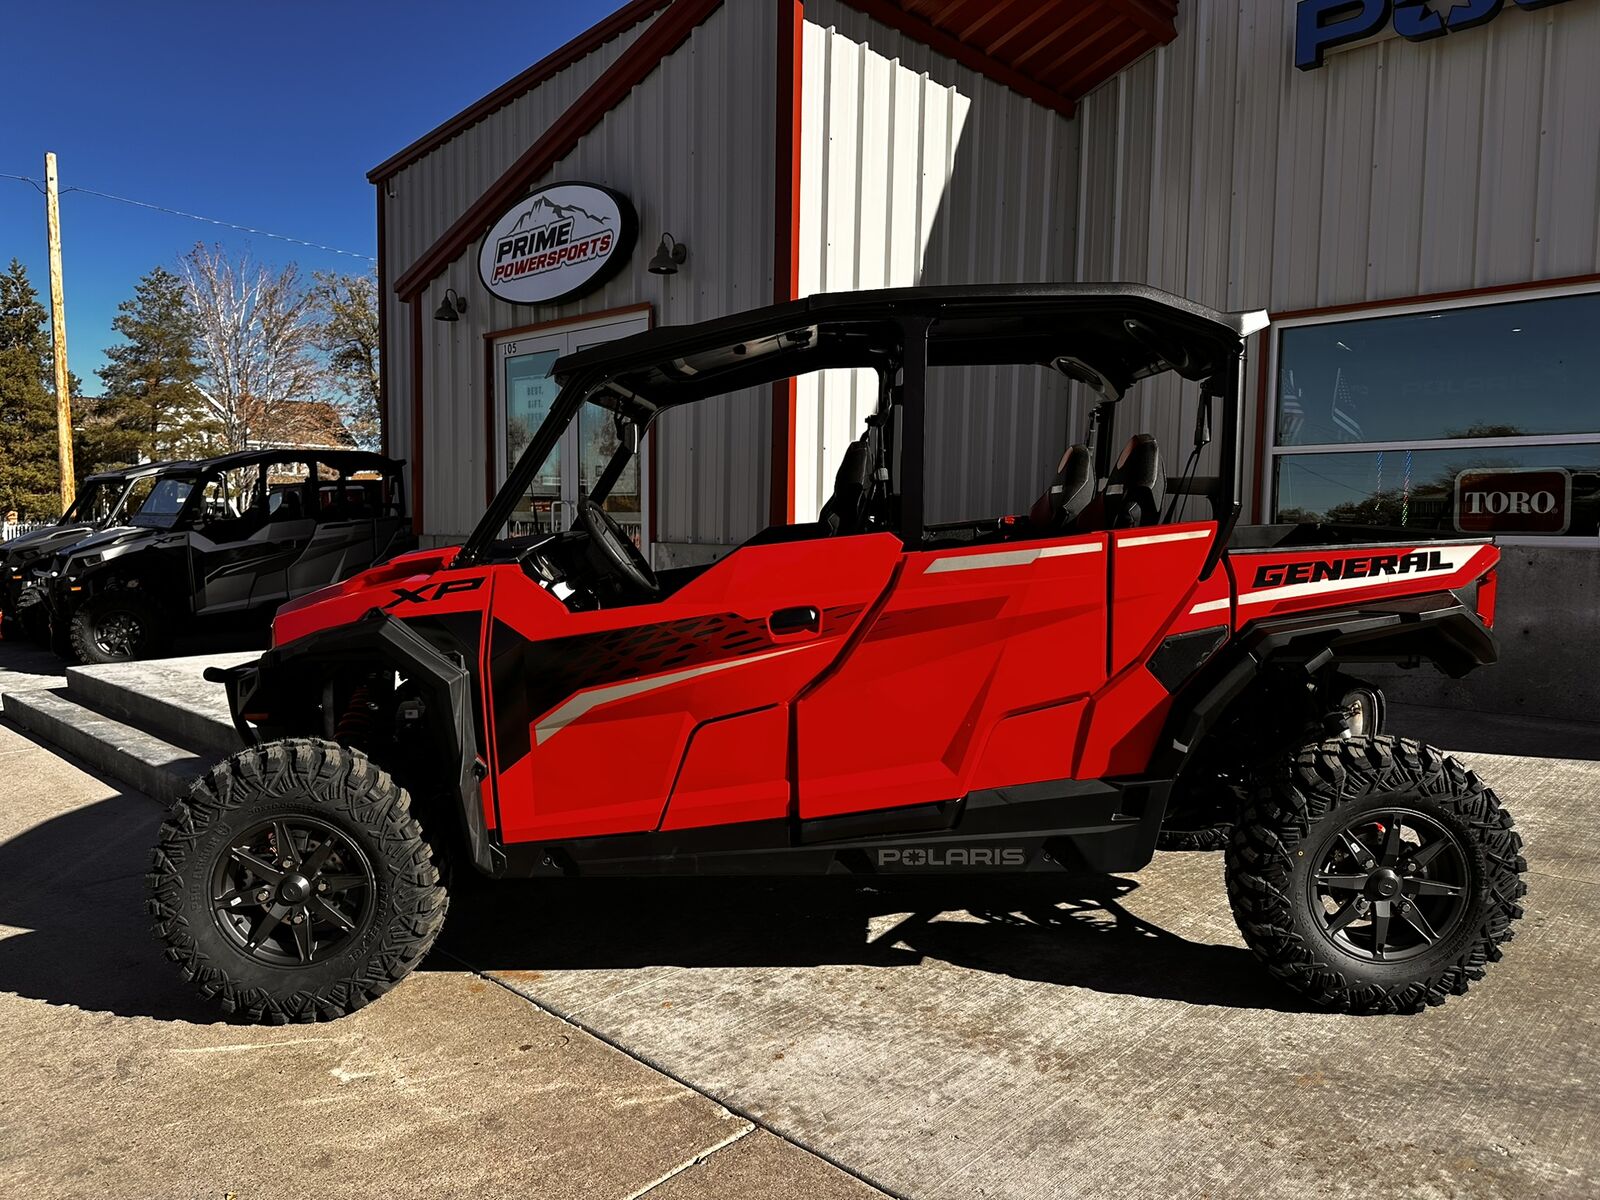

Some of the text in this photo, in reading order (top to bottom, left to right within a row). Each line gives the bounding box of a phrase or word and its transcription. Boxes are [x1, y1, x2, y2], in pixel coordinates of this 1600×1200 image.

[496, 222, 573, 264] PRIME
[493, 234, 613, 281] POWERSPORTS
[503, 342, 517, 355] 105
[1465, 490, 1555, 514] TORO
[152, 534, 186, 546] XP
[1252, 550, 1454, 588] GENERAL
[381, 576, 487, 609] XP
[878, 848, 1025, 866] POLARIS
